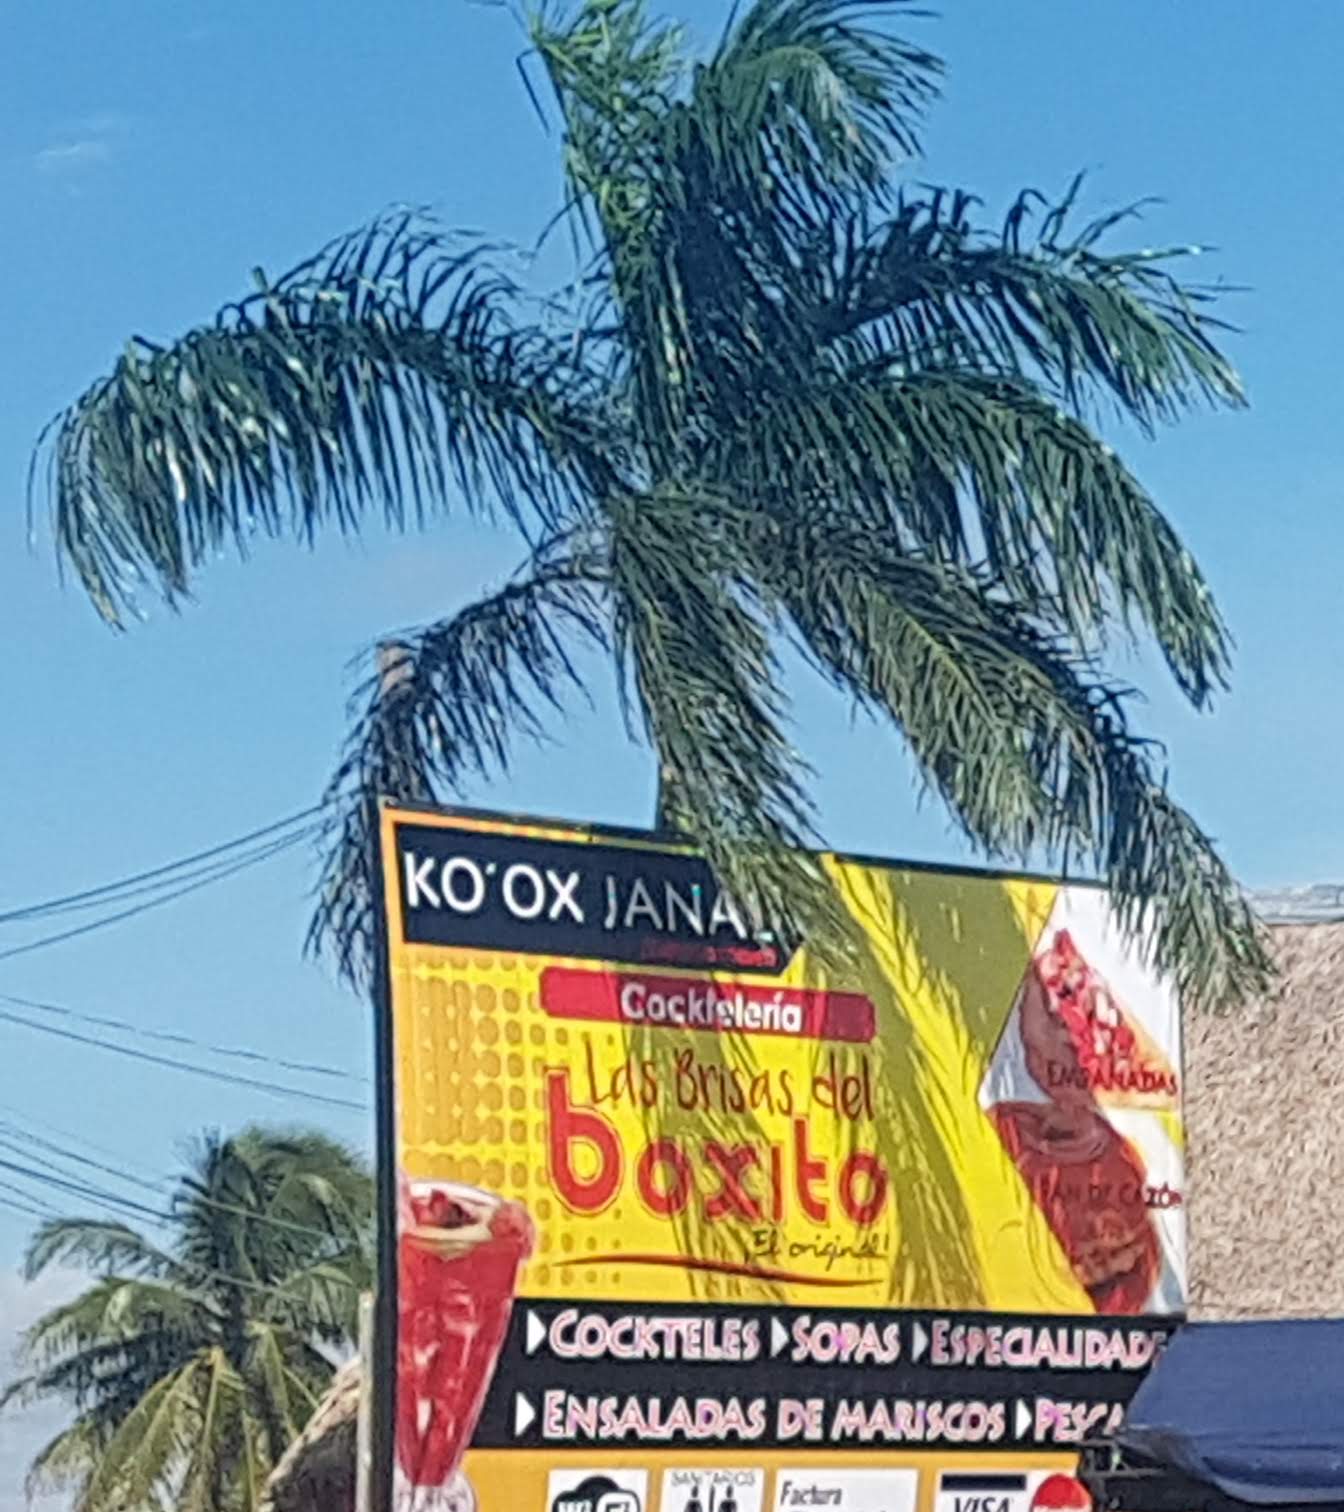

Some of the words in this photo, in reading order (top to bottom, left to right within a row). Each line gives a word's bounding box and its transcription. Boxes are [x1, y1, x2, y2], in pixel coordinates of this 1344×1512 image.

[603, 876, 775, 943] JANA
[620, 983, 803, 1032] Cocktelería
[585, 1037, 658, 1109] Las
[675, 1048, 793, 1116] Brisas
[811, 1052, 874, 1121] del
[544, 1067, 888, 1223] boxito
[550, 1309, 760, 1361] COCKTELES
[791, 1315, 900, 1367] SOPAS
[542, 1389, 767, 1441] ENSALADAS
[776, 1399, 825, 1442] DE
[830, 1398, 1006, 1444] MARISCOS
[781, 1480, 843, 1507] Factura
